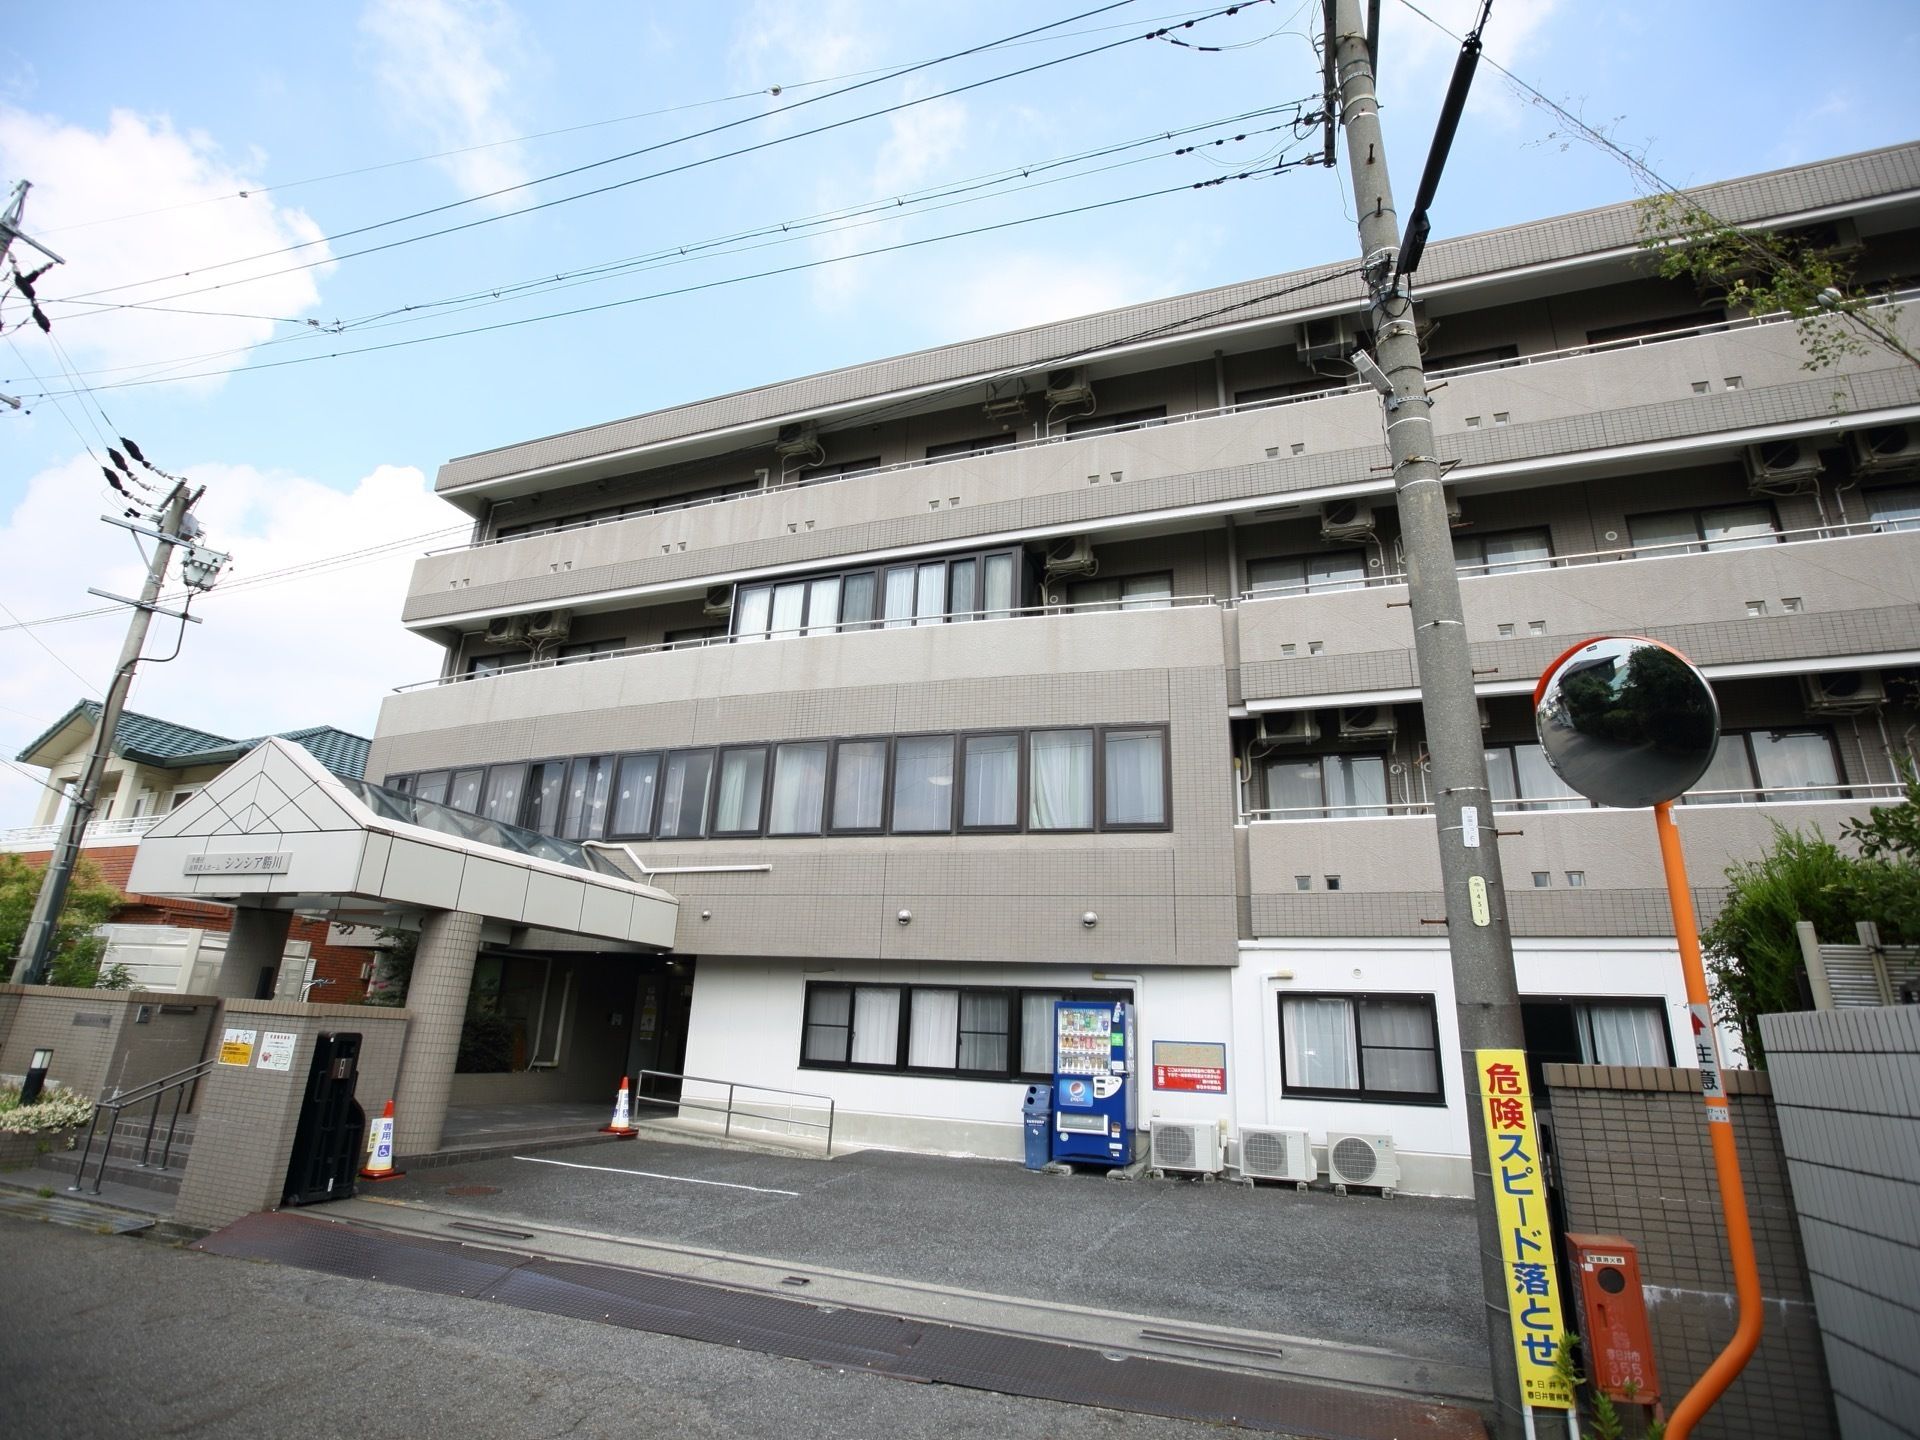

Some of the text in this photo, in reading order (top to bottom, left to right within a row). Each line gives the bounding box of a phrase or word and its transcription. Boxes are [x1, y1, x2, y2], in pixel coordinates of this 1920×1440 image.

[225, 856, 283, 869] シンシア勝川
[1486, 1062, 1560, 1368] 危険スピード落とせ
